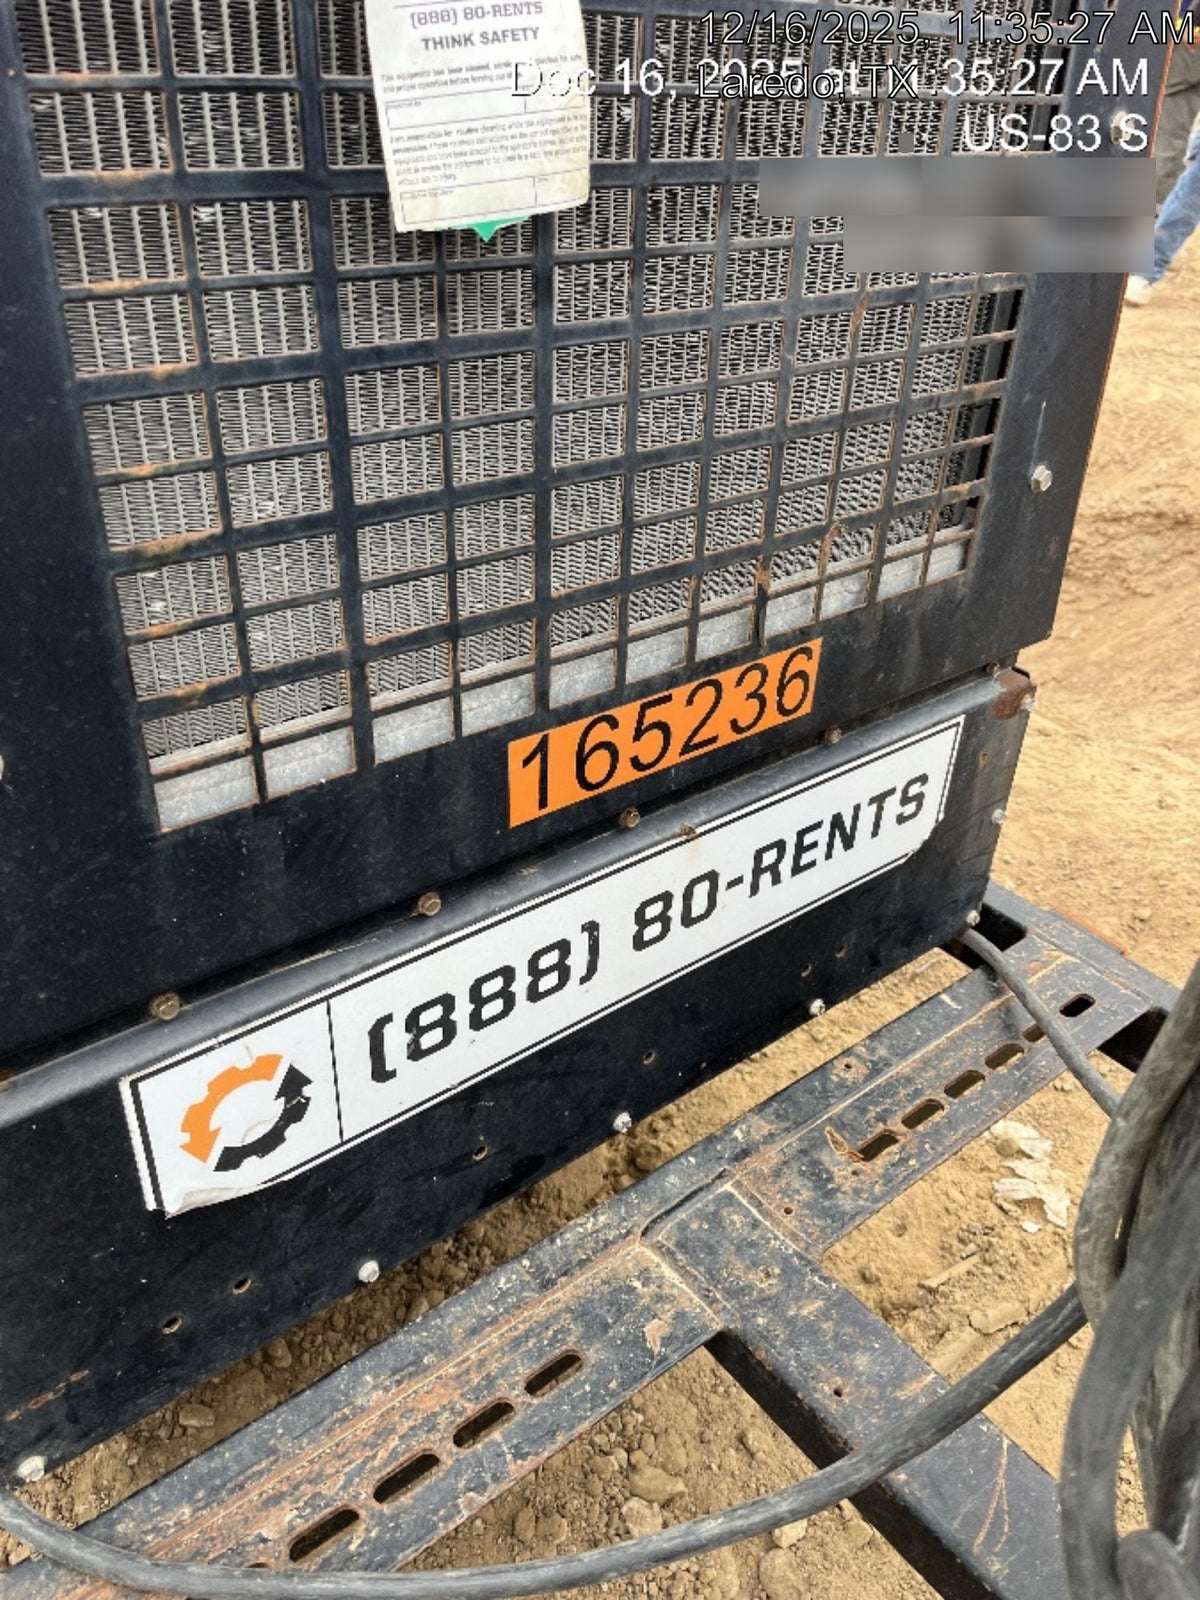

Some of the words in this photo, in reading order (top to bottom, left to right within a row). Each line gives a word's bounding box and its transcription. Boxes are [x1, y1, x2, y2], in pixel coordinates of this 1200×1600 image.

[410, 8, 458, 29] (888)
[463, 1, 544, 21] 80-RENTS
[421, 33, 475, 51] THINK
[480, 27, 540, 45] SAFETY
[521, 646, 814, 811] 165236
[368, 920, 600, 1083] (888)
[631, 772, 929, 951] 80-RENTS
